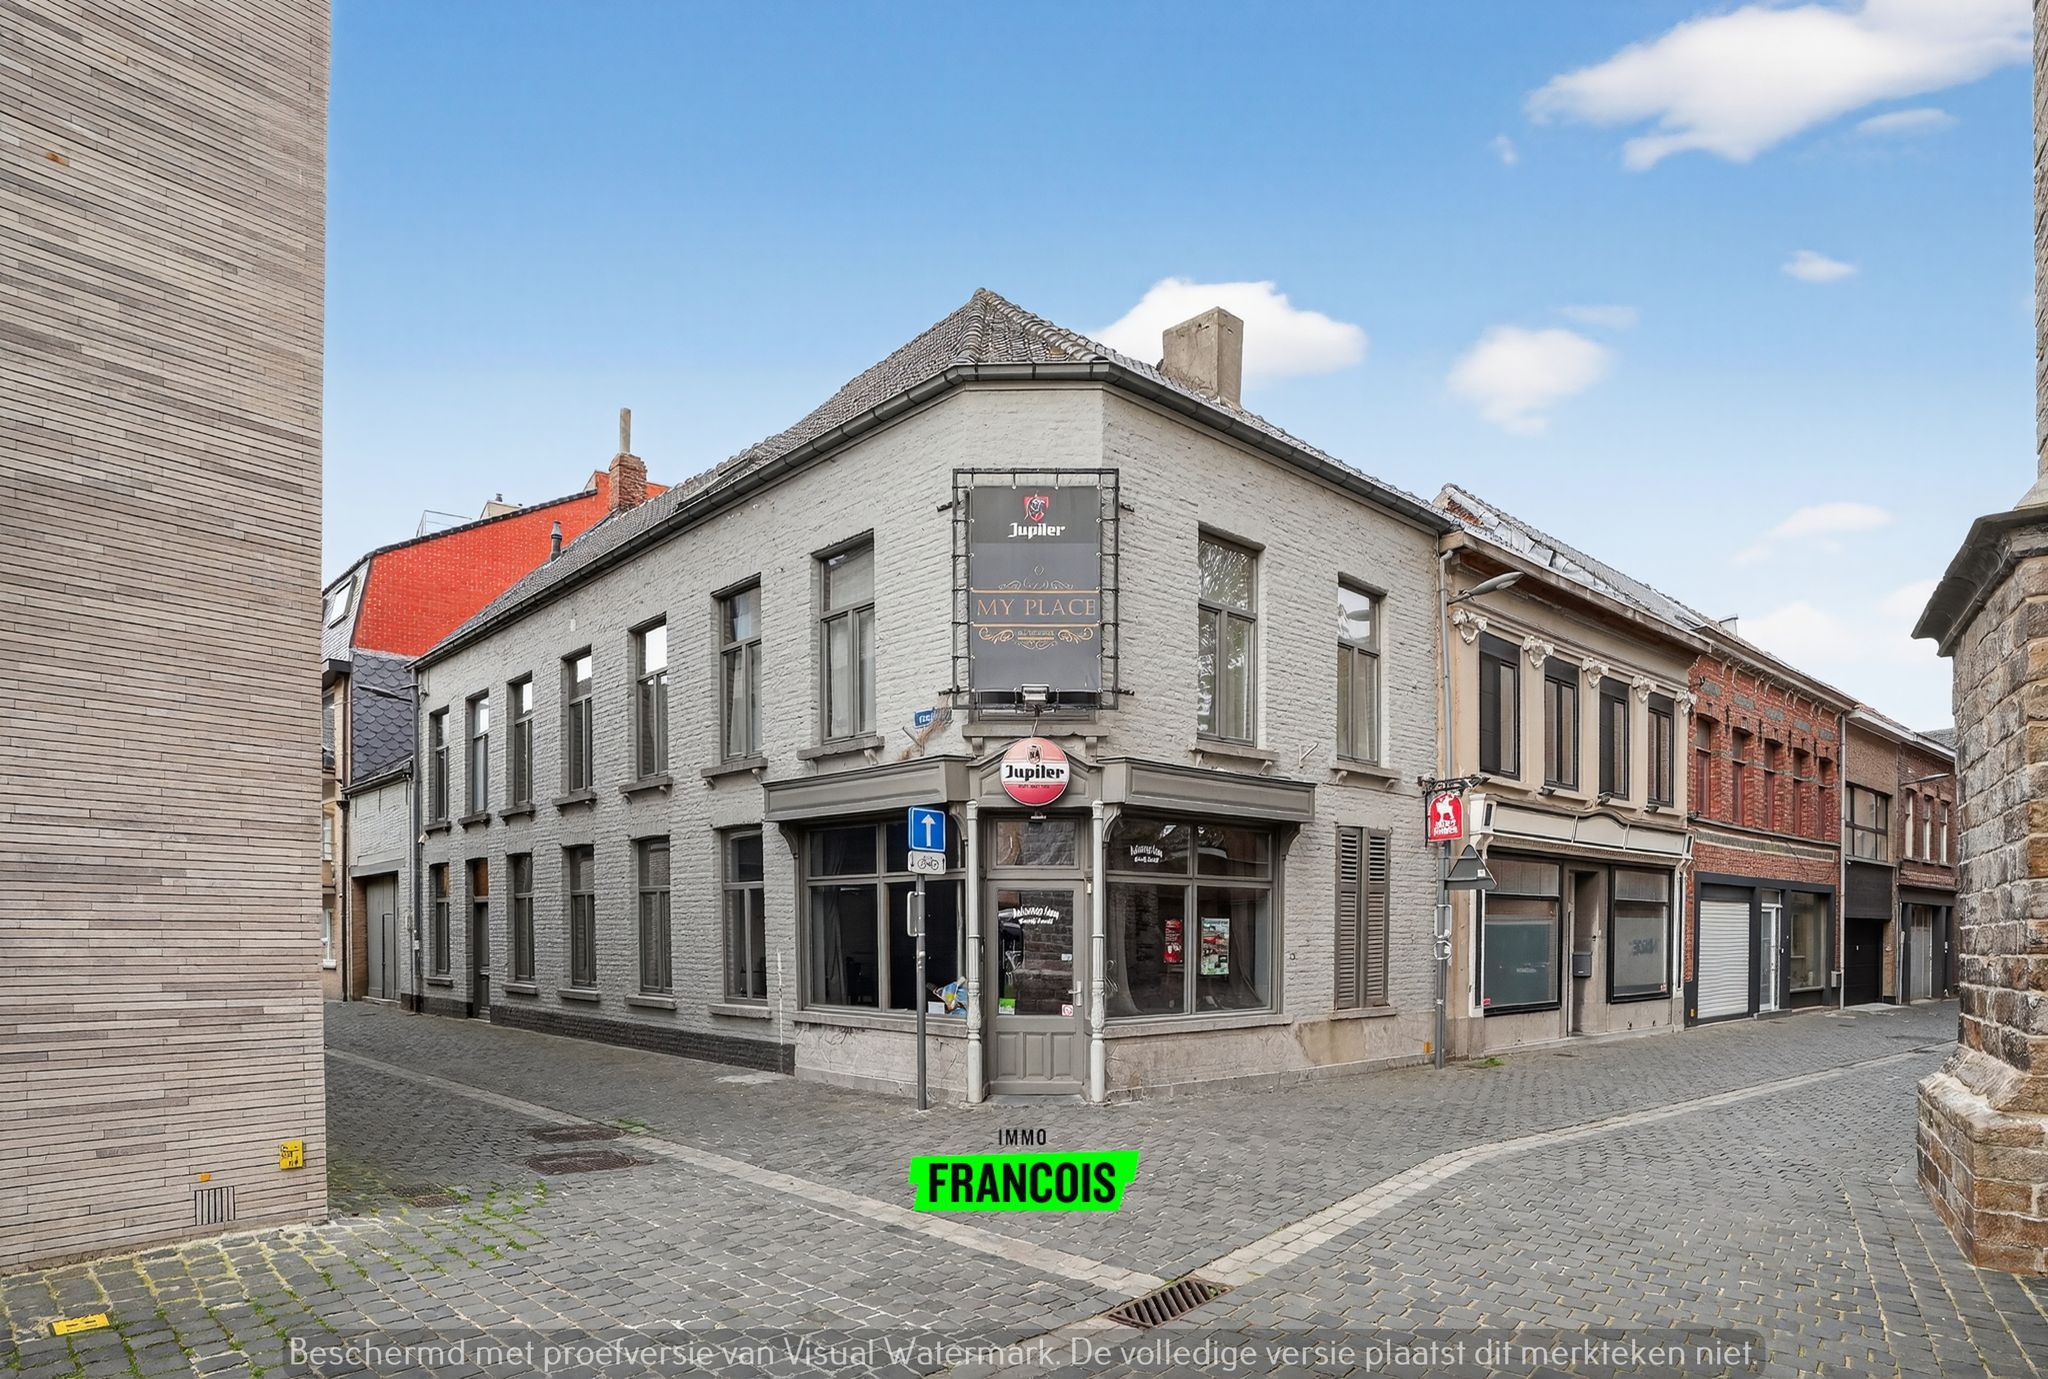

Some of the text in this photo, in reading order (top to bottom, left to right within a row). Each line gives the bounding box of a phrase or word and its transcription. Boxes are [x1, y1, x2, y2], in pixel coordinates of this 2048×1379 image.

[1008, 522, 1066, 539] Jupiler
[977, 598, 1096, 616] MY PLACE
[1005, 764, 1065, 782] Jupiler
